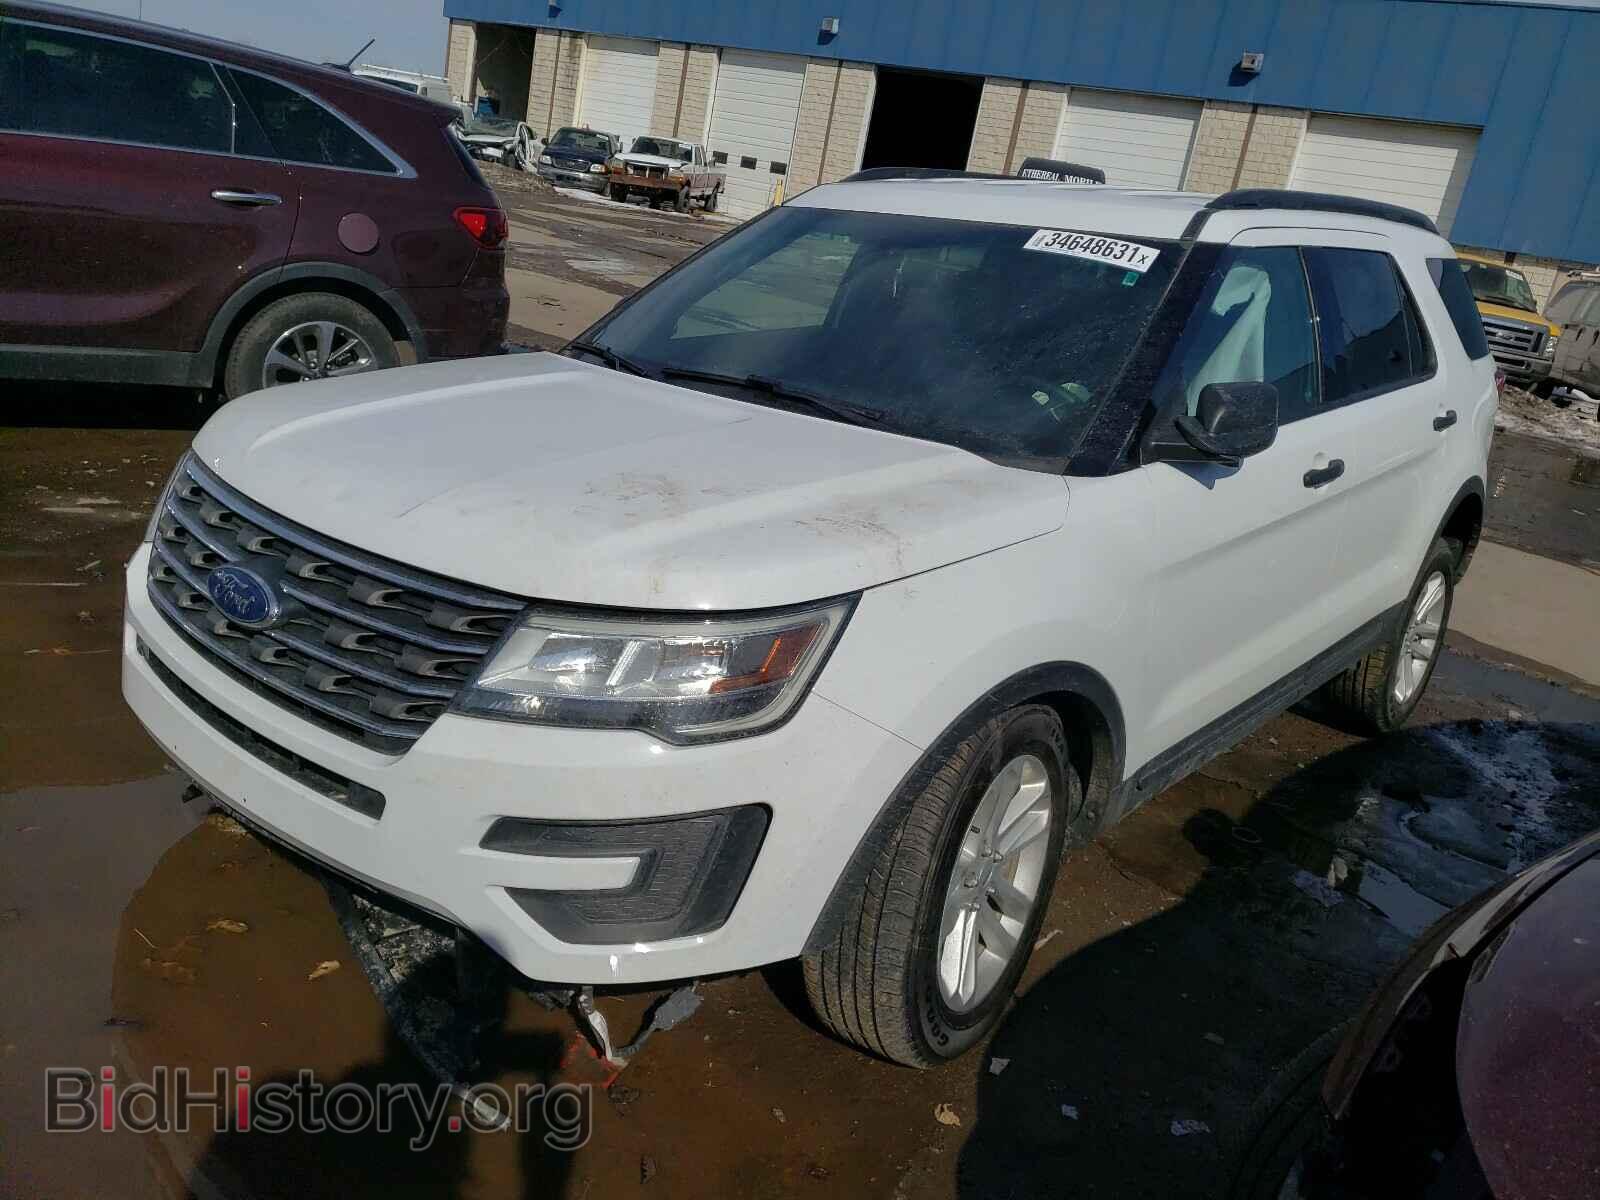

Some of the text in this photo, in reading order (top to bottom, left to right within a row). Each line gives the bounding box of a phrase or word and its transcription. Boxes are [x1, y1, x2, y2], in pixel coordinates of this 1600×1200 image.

[1021, 168, 1059, 181] ETHEREAL
[1045, 232, 1140, 262] 34648631
[213, 573, 256, 616] Ford
